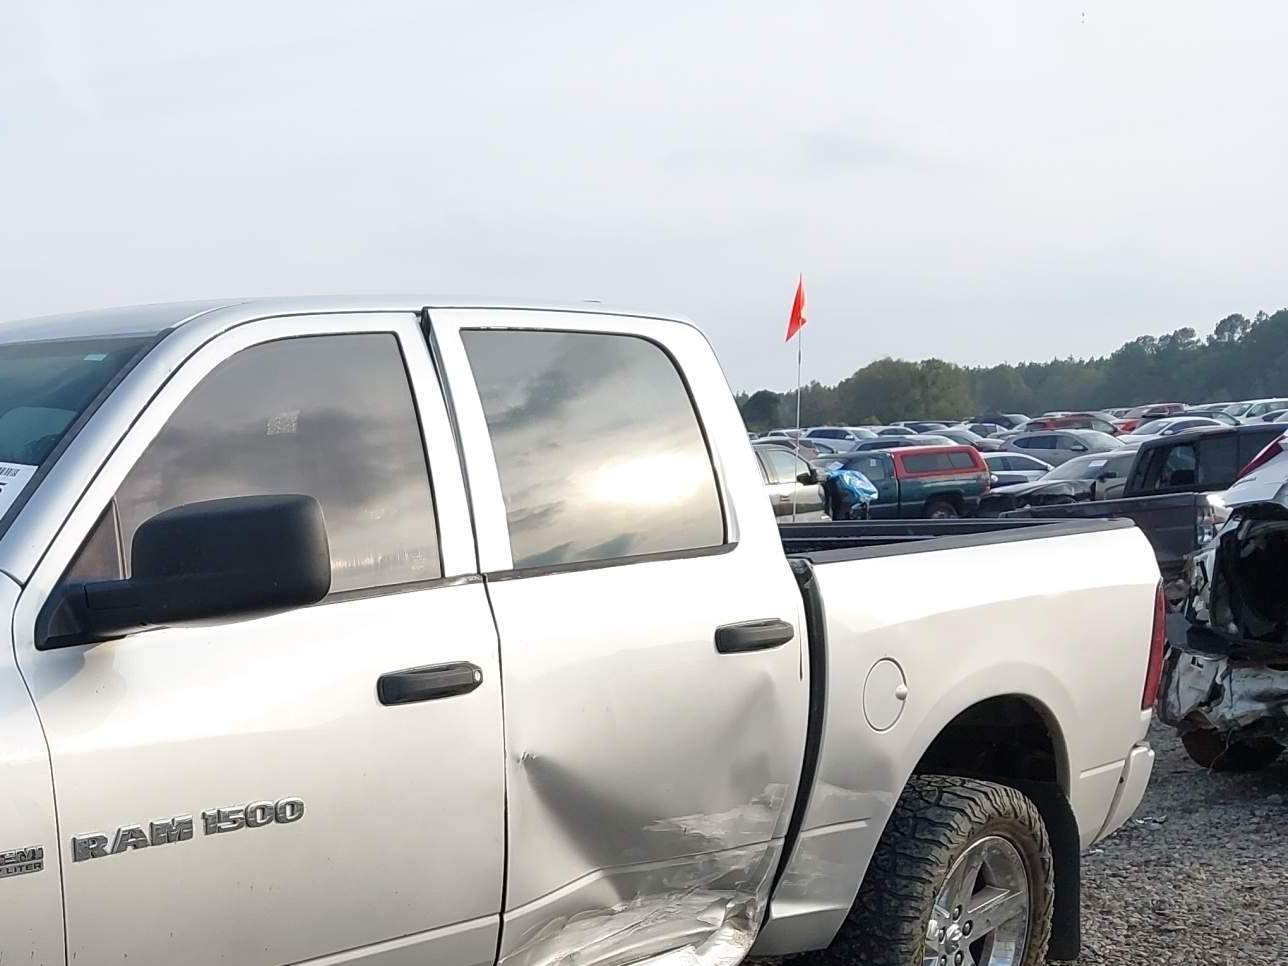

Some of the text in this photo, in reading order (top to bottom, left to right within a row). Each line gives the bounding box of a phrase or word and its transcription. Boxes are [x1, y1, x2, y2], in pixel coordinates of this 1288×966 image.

[70, 796, 306, 864] RAM 1500
[6, 862, 43, 874] LITER
